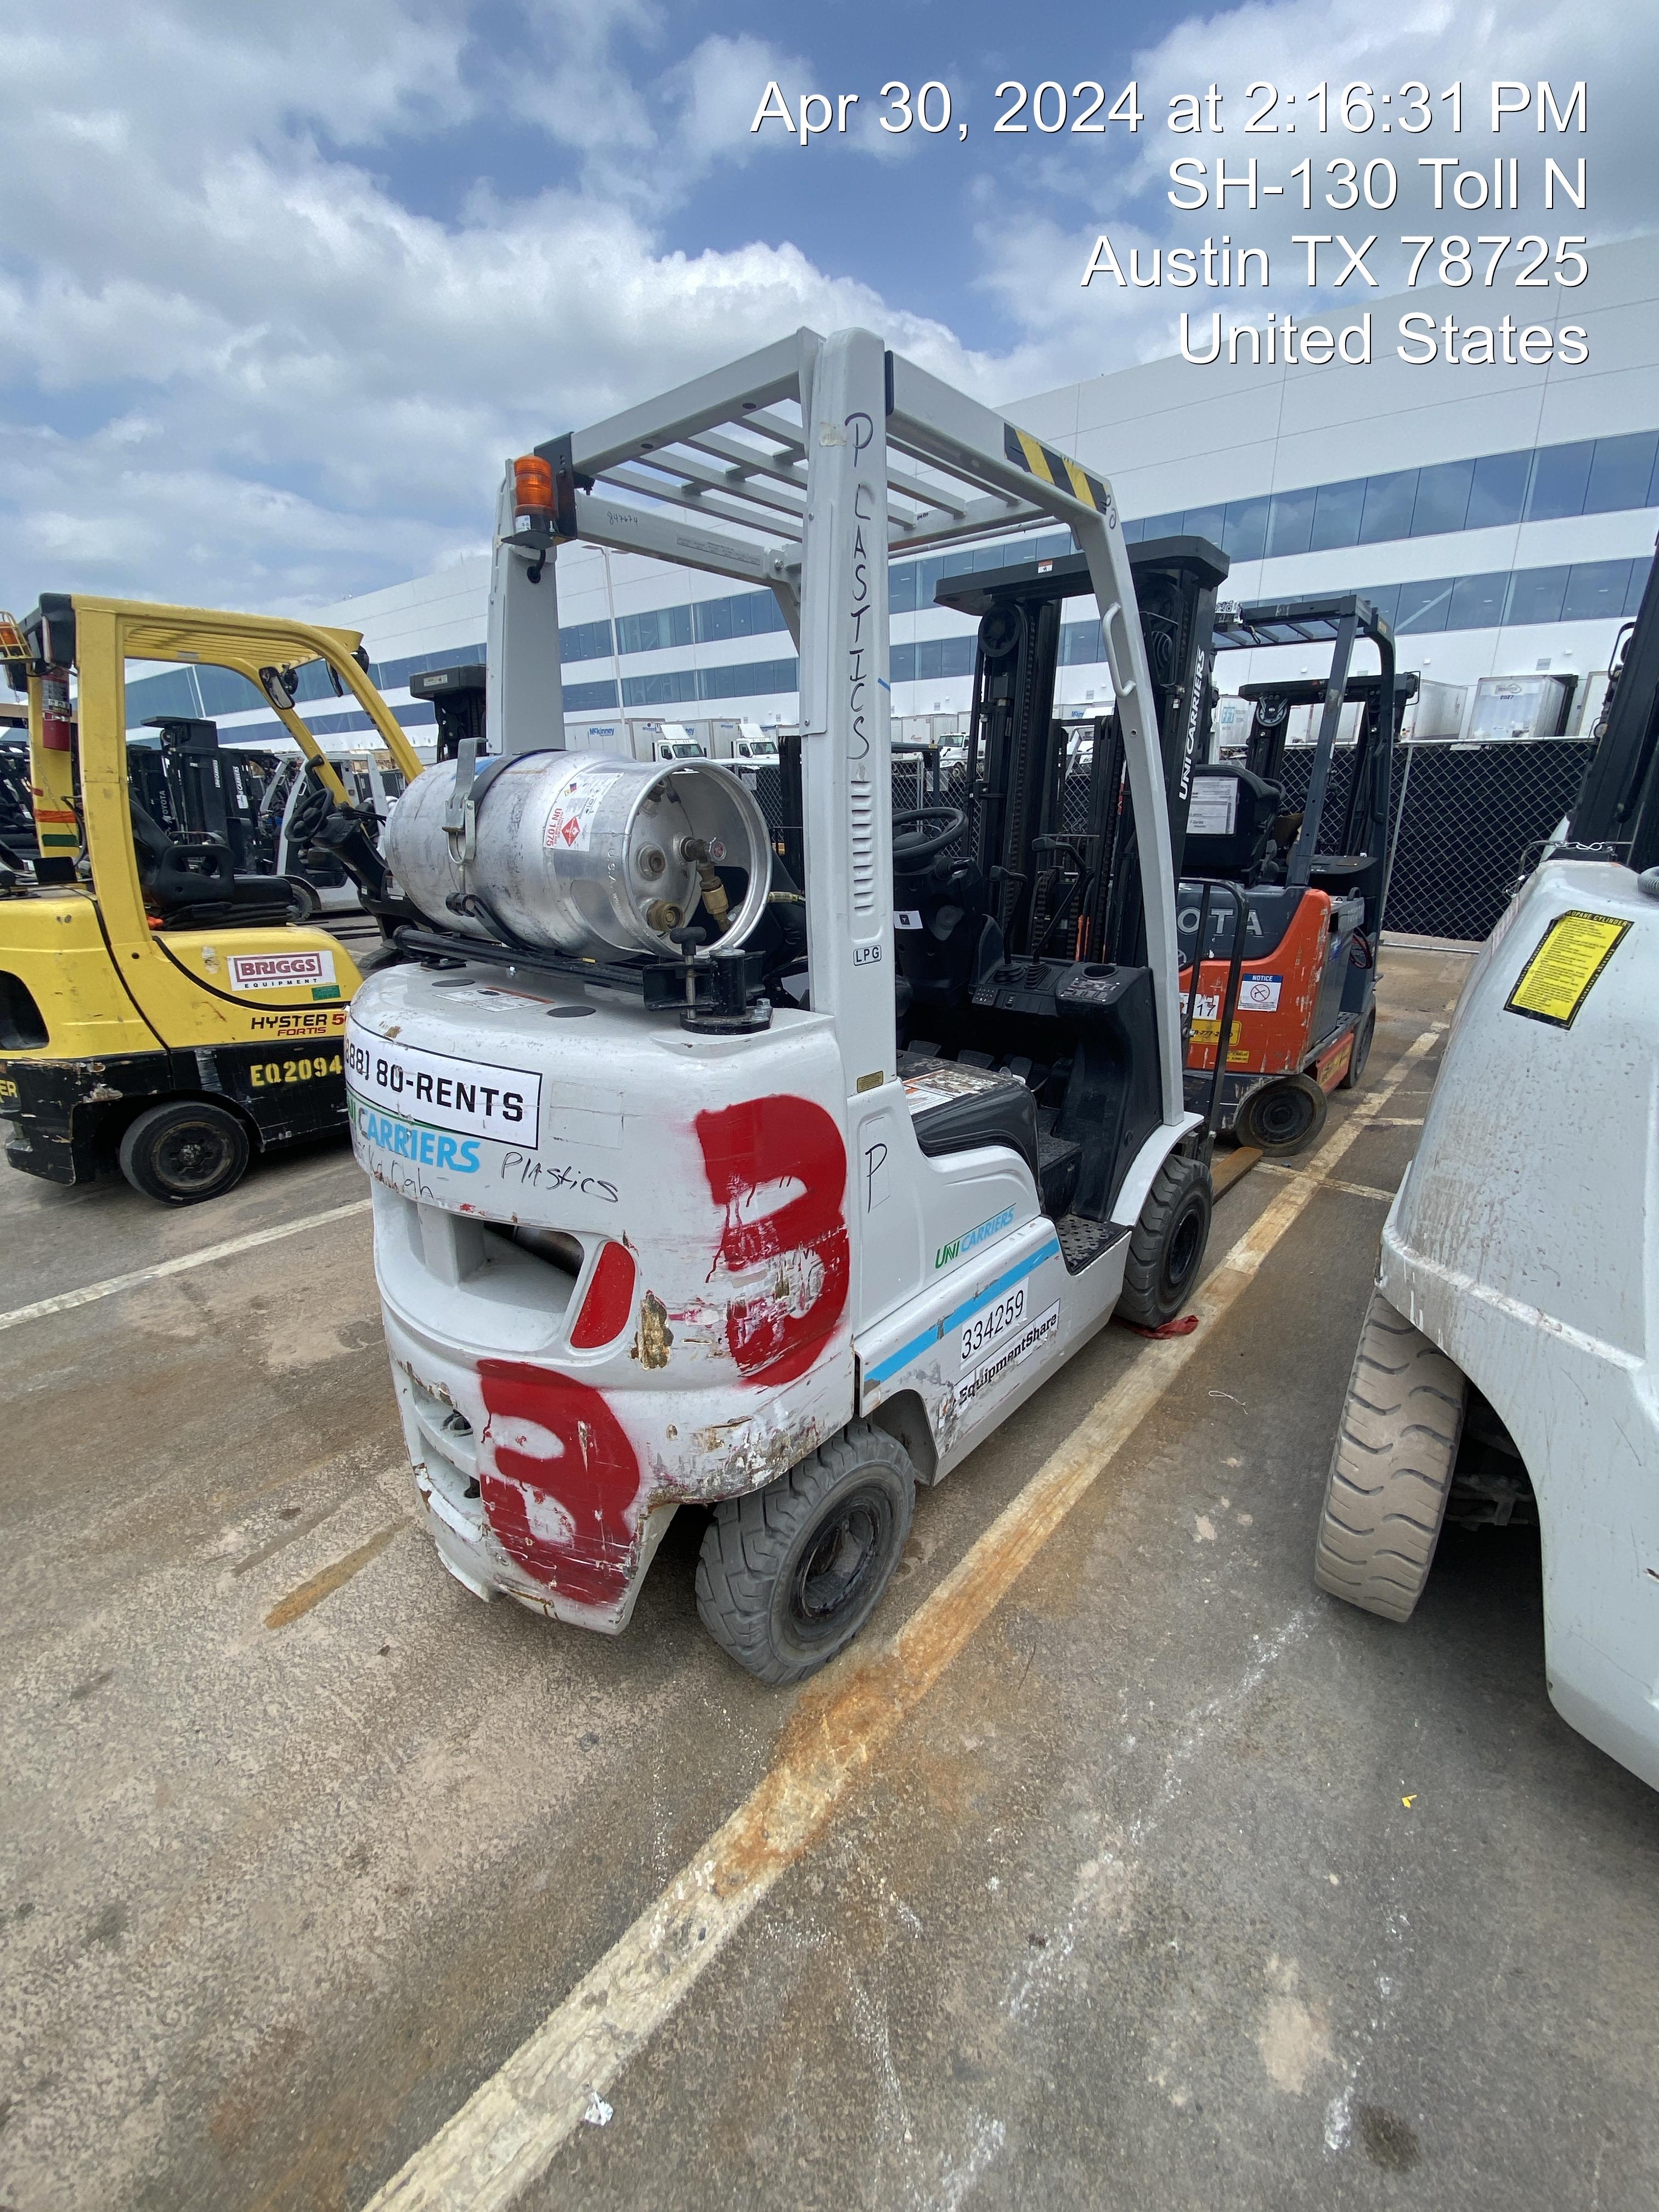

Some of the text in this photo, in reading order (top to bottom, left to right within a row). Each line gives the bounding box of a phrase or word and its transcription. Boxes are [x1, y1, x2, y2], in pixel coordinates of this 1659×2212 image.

[546, 823, 556, 847] 1075
[856, 946, 879, 963] LPG
[240, 959, 316, 976] BRIGGS
[245, 978, 318, 988] EQUIPMENT
[251, 1013, 346, 1030] HYSTER 5
[277, 1026, 327, 1036] FORTIS
[250, 1054, 343, 1087] EQ2094
[376, 1058, 523, 1122] 80-RENTS
[865, 1143, 888, 1214] P
[961, 1289, 1024, 1359] 334259
